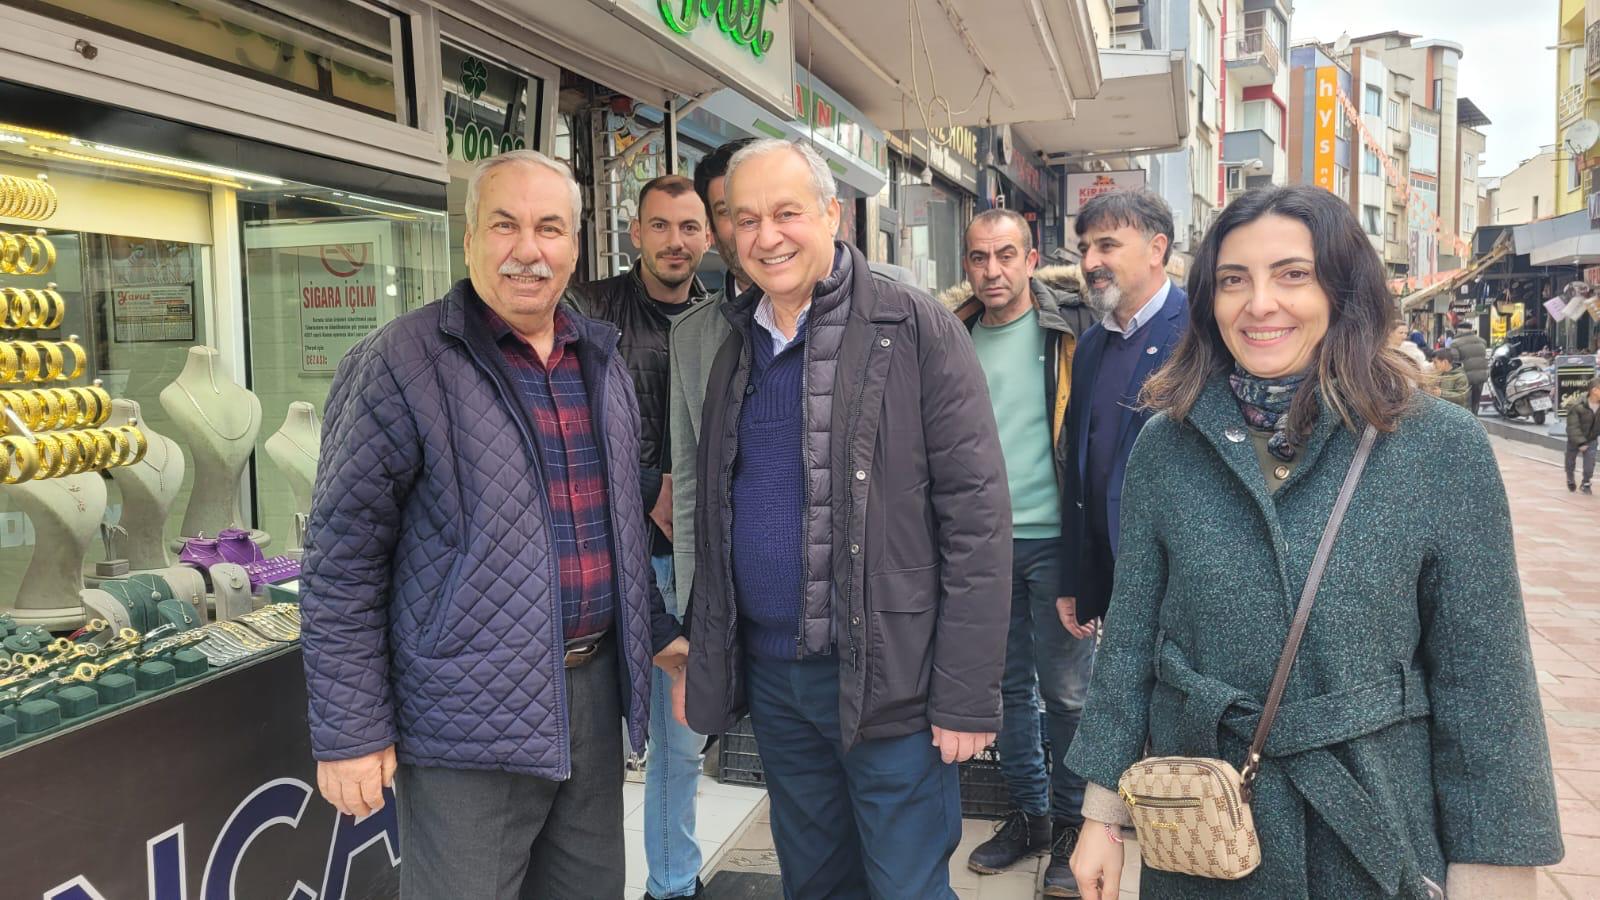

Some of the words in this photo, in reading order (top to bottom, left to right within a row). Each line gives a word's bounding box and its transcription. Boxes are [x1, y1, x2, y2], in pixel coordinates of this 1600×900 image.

[1319, 78, 1333, 154] hys
[949, 125, 977, 166] HOME
[303, 280, 342, 309] SİGARA
